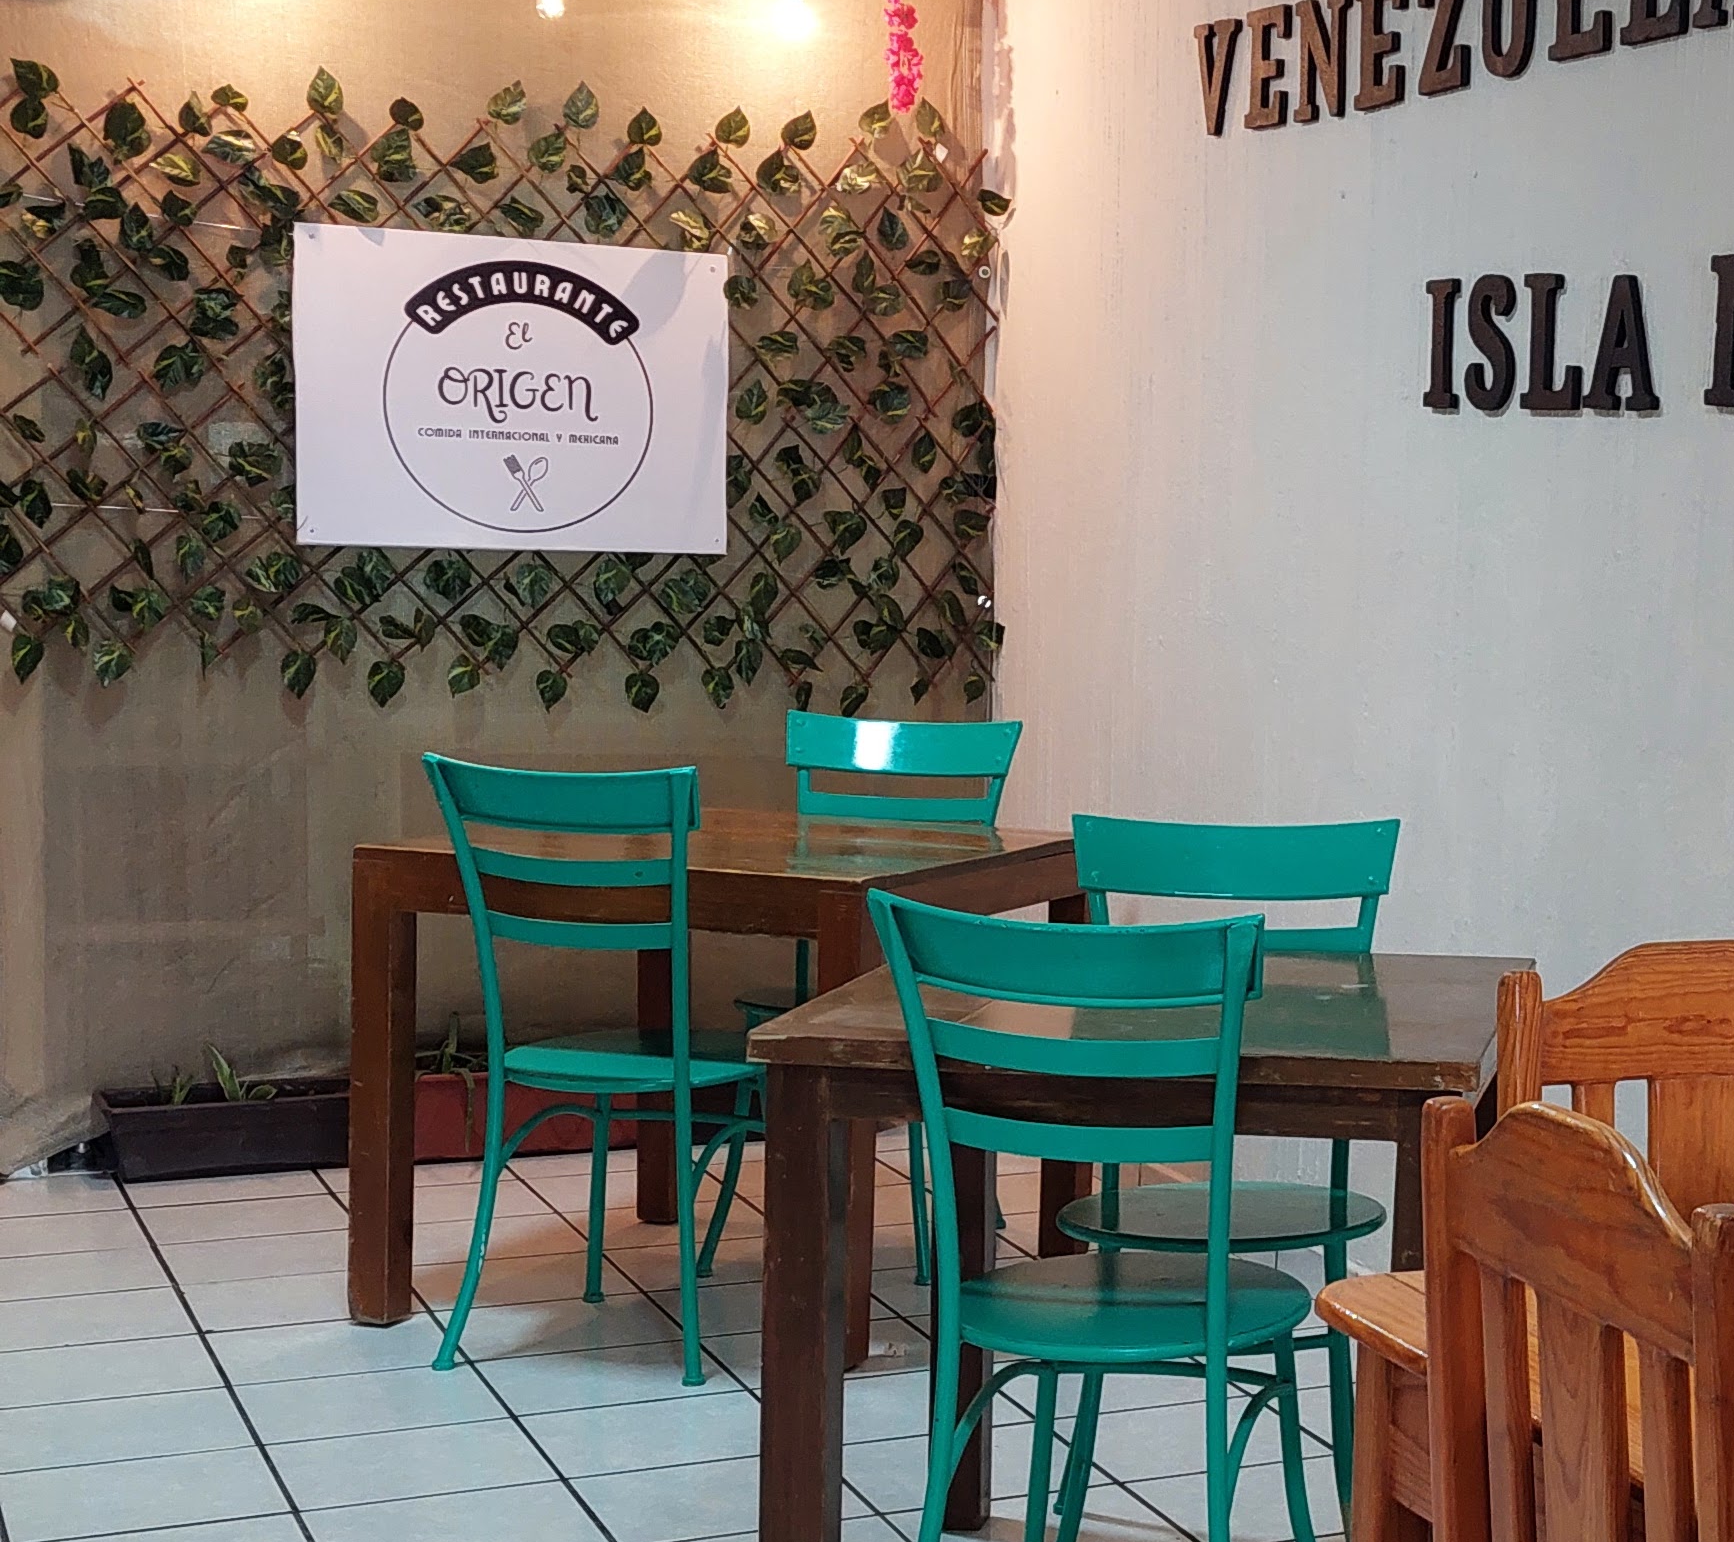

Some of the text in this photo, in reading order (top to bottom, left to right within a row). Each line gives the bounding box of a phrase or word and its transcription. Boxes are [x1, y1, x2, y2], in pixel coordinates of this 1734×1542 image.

[415, 271, 631, 339] RESTAURANTE
[1423, 273, 1659, 413] ISLA
[417, 427, 619, 446] COMIDA INTERNACIONAL Y MEXICANA
